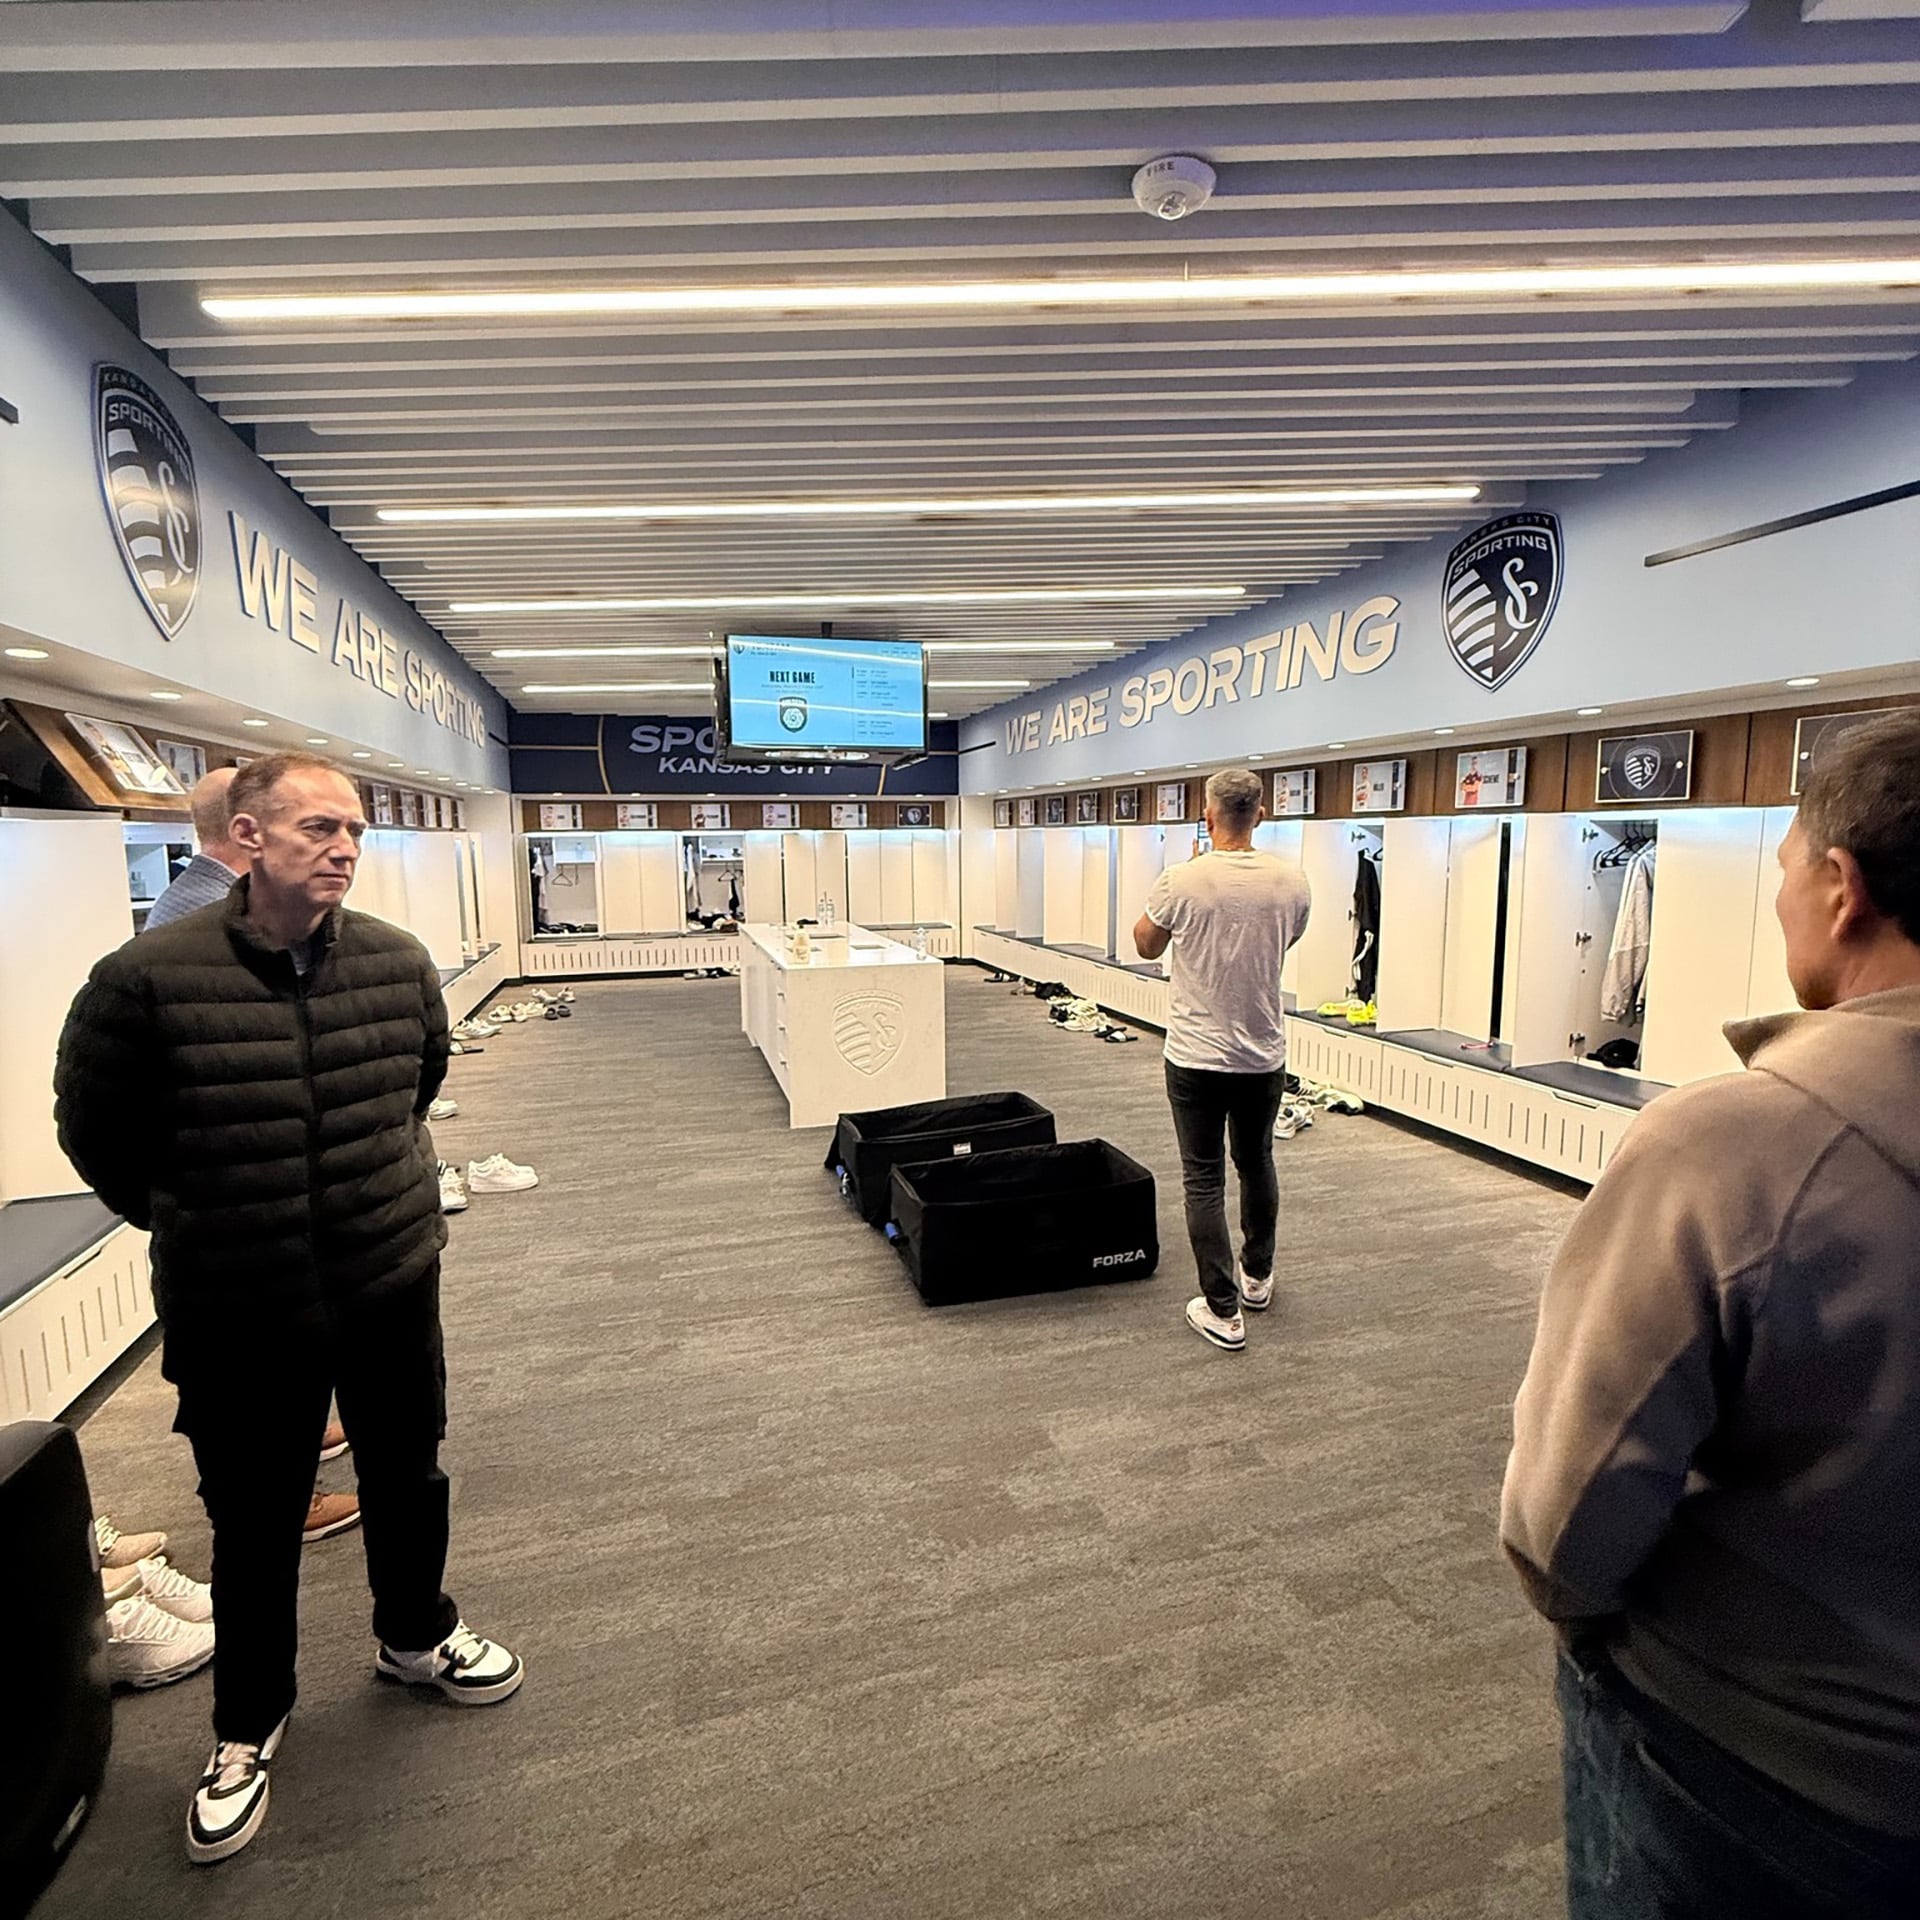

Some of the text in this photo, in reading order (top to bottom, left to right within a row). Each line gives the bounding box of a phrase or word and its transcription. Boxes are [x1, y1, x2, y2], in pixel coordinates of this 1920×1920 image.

[1516, 515, 1551, 526] CITY
[1452, 534, 1548, 581] SPORTING
[228, 510, 486, 749] WE ARE SPORTING
[769, 671, 815, 684] NEXT GAME
[1006, 596, 1401, 756] WE ARE SPORTING
[1093, 1249, 1146, 1268] FORZA
